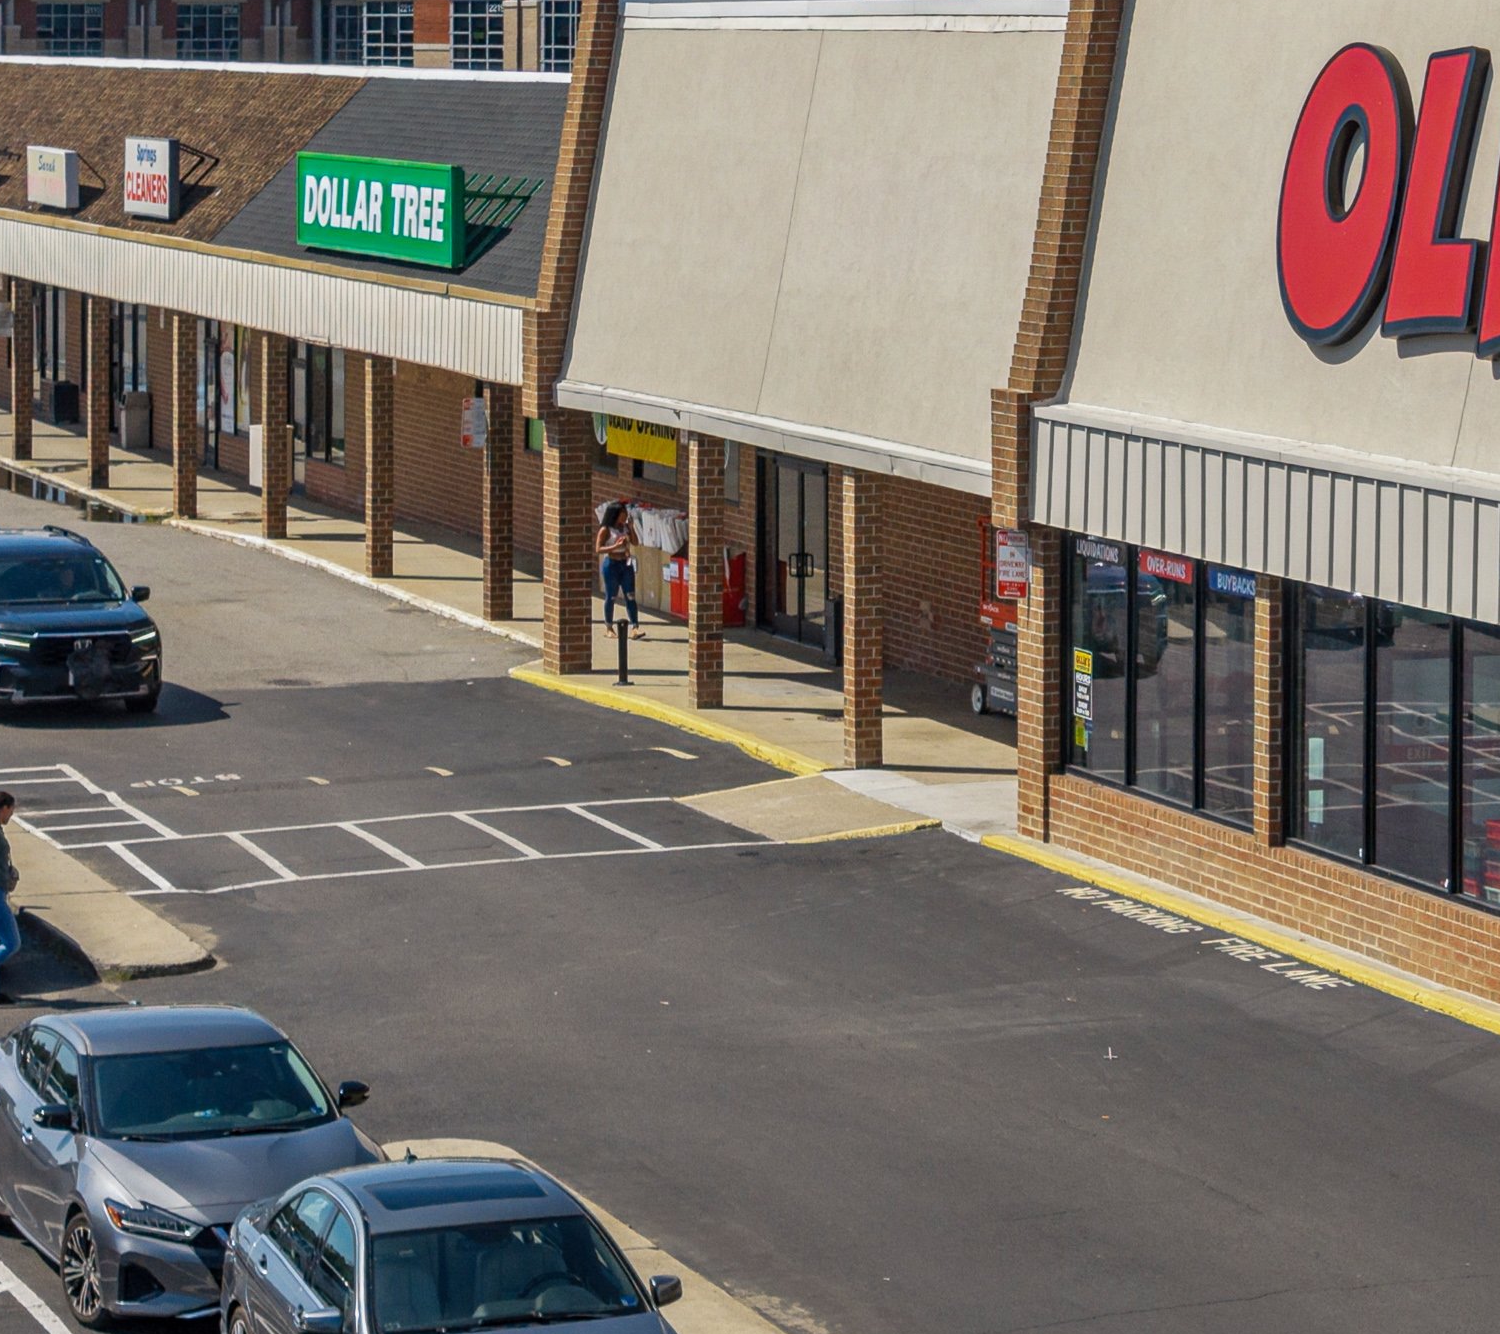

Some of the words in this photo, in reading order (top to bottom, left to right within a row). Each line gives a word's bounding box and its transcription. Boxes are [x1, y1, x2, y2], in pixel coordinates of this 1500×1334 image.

[136, 144, 157, 167] Springs
[126, 171, 168, 205] CLEANERS
[303, 175, 383, 233] DOLLAR
[391, 184, 446, 242] TREE
[1075, 539, 1119, 564] LIQUIDATIONS
[1146, 555, 1186, 580] OVER-RUNS
[1217, 572, 1256, 596] BUYBACKS
[129, 772, 242, 789] STOP
[1056, 886, 1110, 900] NO
[1091, 899, 1204, 934] PARKING
[1201, 937, 1283, 962] FIRE
[1259, 961, 1355, 990] LANE
